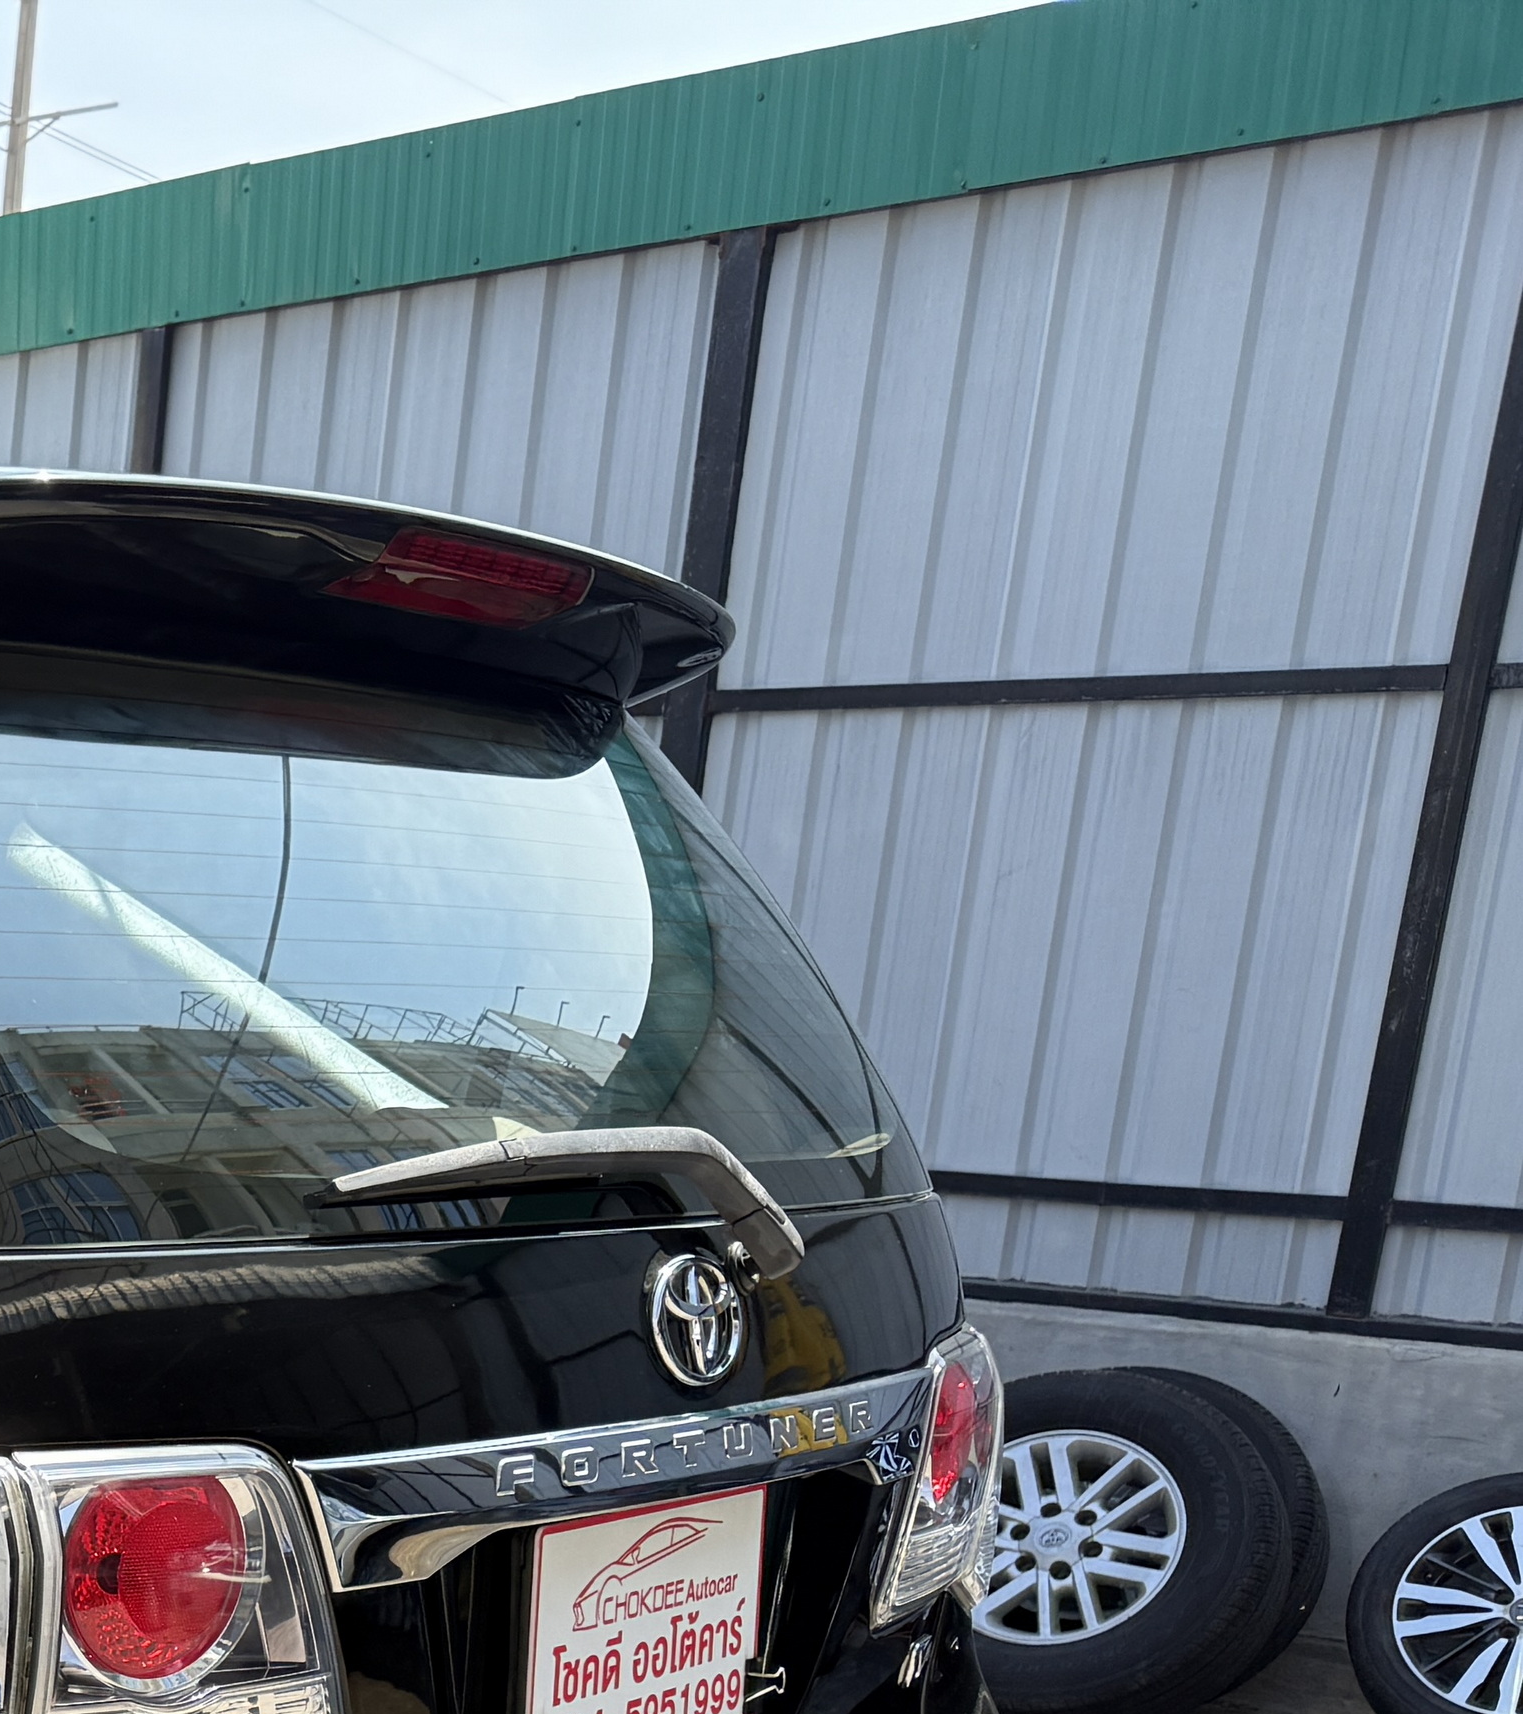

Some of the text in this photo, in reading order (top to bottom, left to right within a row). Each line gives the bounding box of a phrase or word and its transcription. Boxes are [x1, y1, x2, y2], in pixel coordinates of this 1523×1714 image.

[496, 1400, 874, 1496] FORTUNER
[602, 1573, 738, 1625] CHOKDEE Autocar
[553, 1597, 746, 1706] โชคดี ออโต้คาร์
